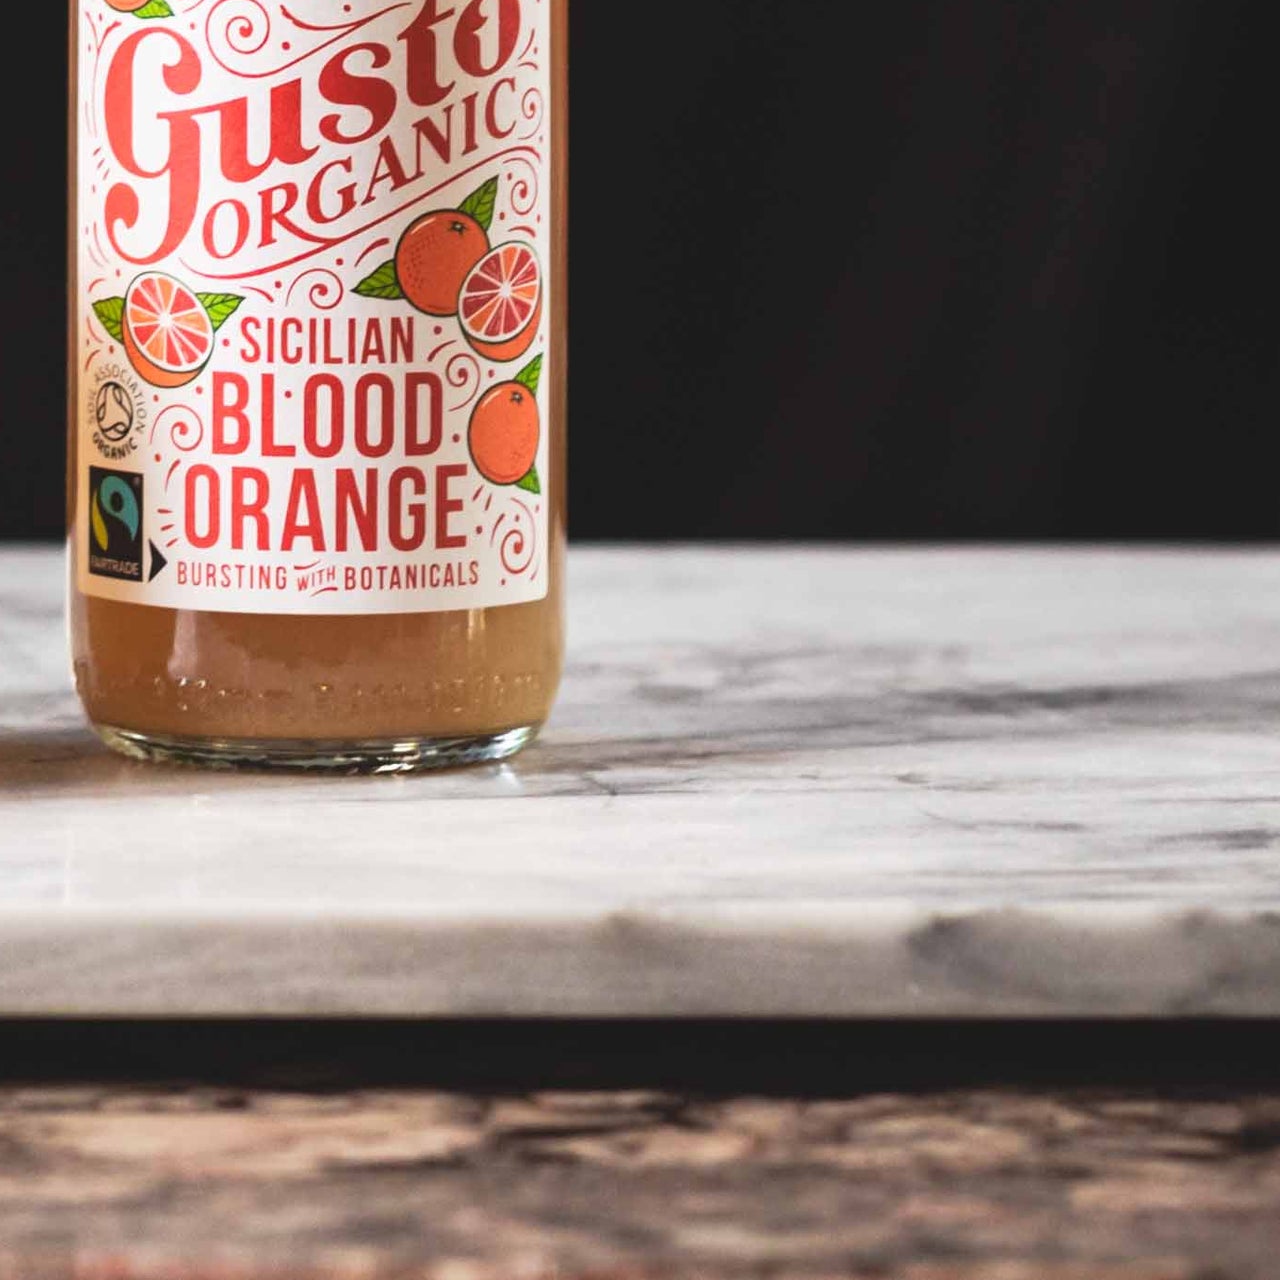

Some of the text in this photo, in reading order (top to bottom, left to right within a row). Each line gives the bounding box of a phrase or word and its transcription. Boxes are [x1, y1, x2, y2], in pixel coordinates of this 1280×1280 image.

[202, 77, 517, 260] ORGANIC
[240, 317, 414, 365] SICILIAN
[211, 371, 441, 458] BLOOD
[183, 464, 467, 552] ORANGE
[177, 560, 479, 592] BURSTING WITH BOTANICALS
